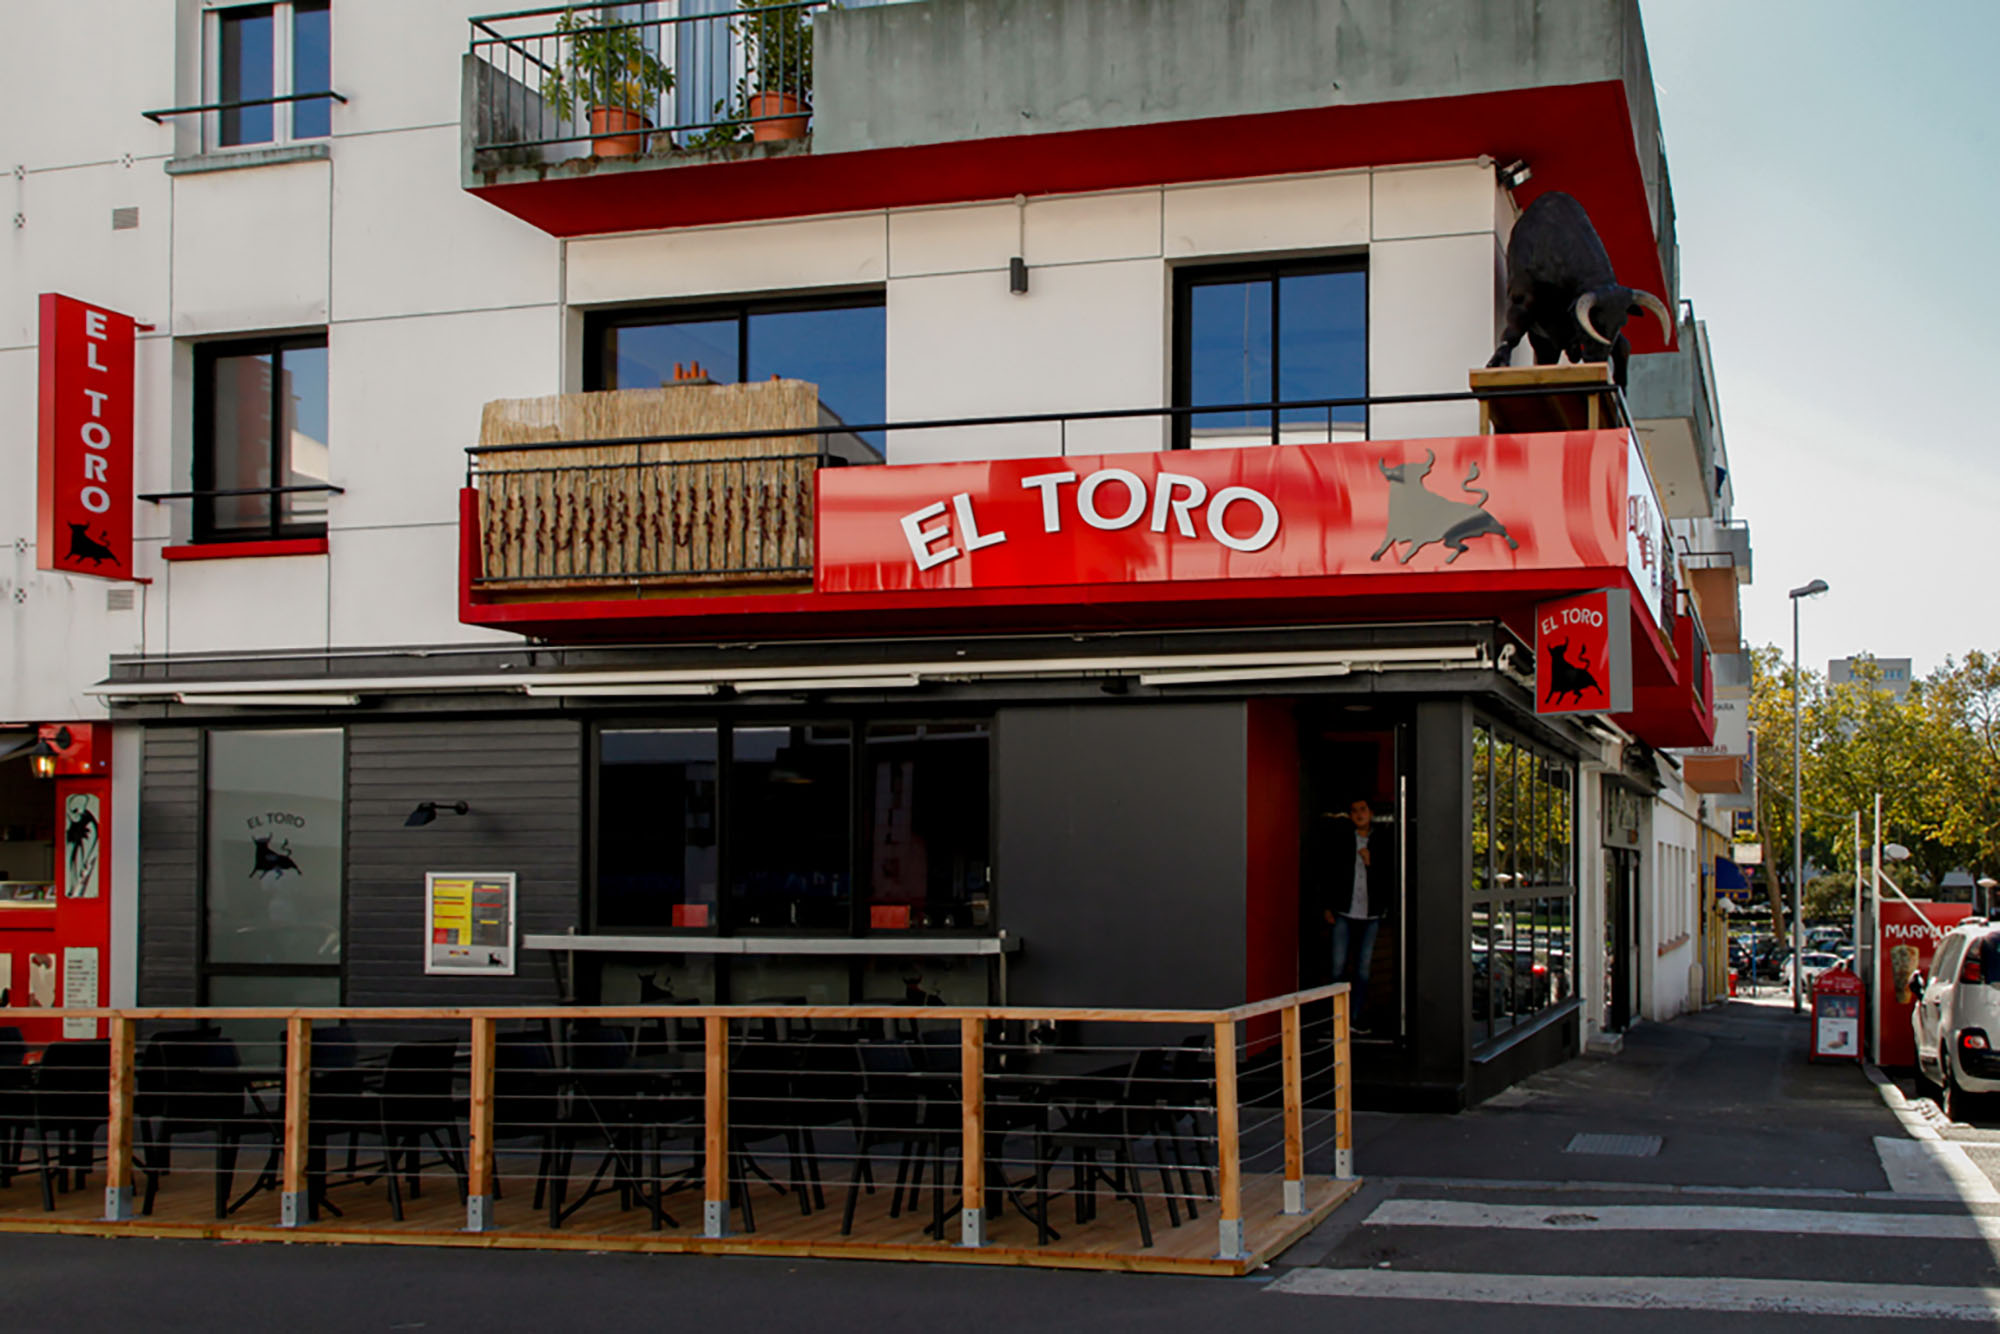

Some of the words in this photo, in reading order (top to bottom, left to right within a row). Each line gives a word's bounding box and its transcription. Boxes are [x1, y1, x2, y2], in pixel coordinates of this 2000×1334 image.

[85, 310, 108, 372] EL
[80, 389, 111, 513] TORO
[900, 492, 1007, 571] EL
[1021, 468, 1280, 552] TORO
[1541, 616, 1558, 635] EL
[1560, 607, 1603, 628] TORO
[246, 815, 264, 829] EL
[265, 812, 305, 829] TORO
